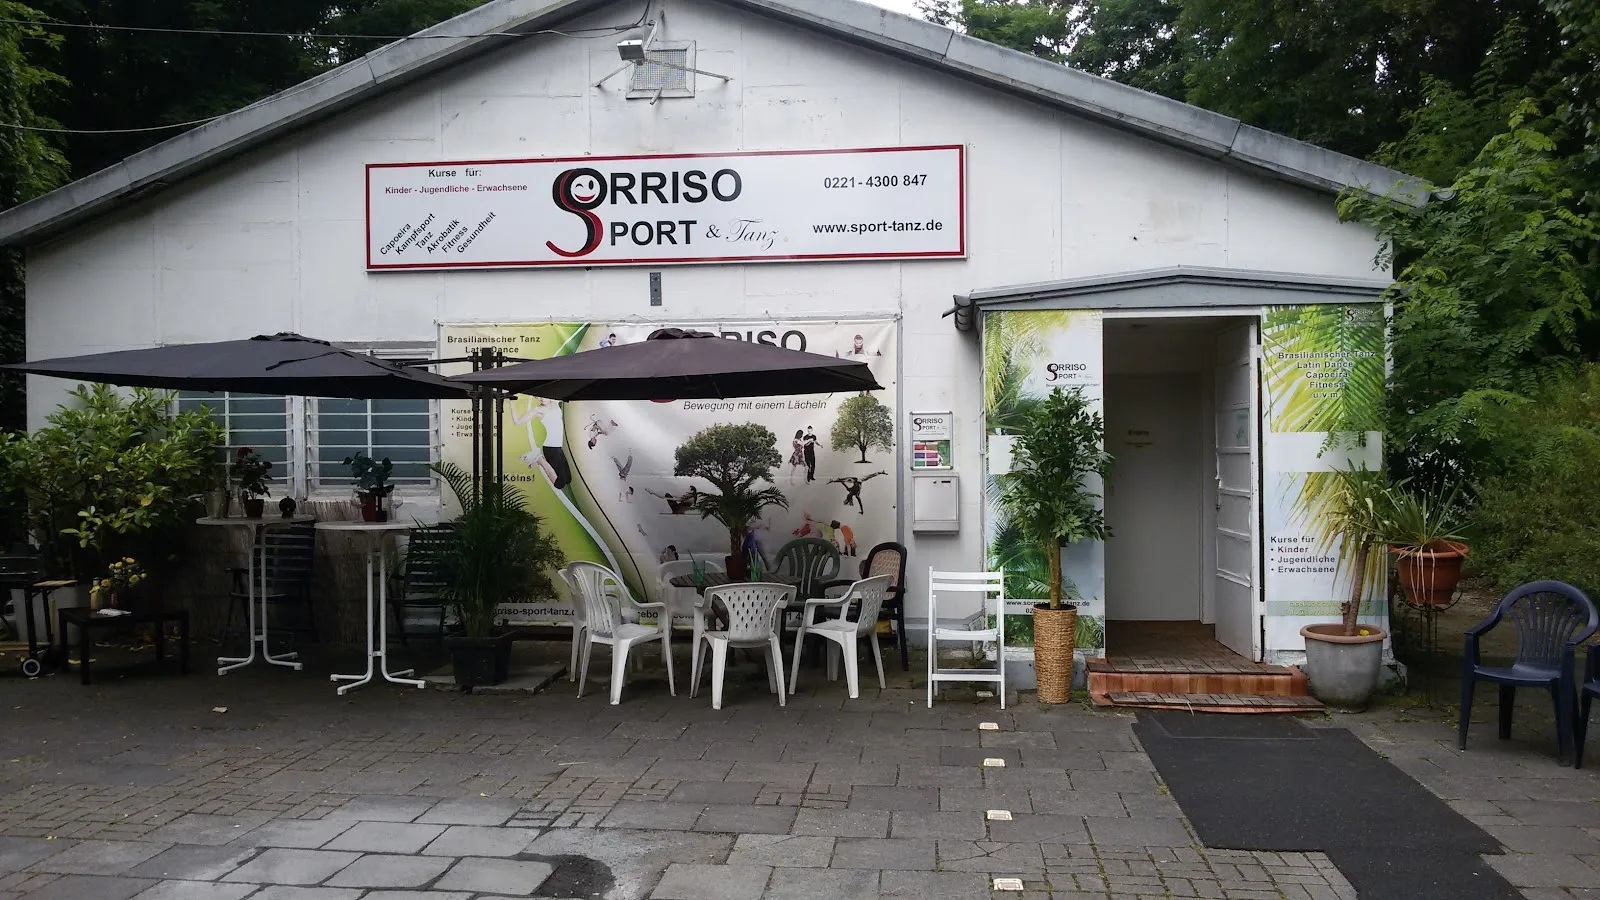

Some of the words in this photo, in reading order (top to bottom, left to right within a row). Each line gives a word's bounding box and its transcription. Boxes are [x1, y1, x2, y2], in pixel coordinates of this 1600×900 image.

[428, 169, 457, 178] Kurse
[465, 168, 482, 177] für:
[903, 174, 927, 186] 847
[385, 186, 412, 194] Kinder
[419, 185, 470, 195] Jugendliche
[476, 184, 528, 192] Erwachsene
[457, 211, 497, 254] Gesundheit
[813, 219, 943, 235] www.sport-tanz.de
[380, 223, 411, 255] Capoeira
[395, 213, 436, 255] Kampfsport
[427, 219, 460, 255] Akrobatik
[441, 226, 469, 254] Fitness
[706, 224, 721, 239] &
[726, 218, 779, 251] Tanz
[415, 231, 434, 250] Tanz
[519, 335, 541, 343] Tanz
[1278, 351, 1350, 359] Brasilianischer
[1354, 350, 1376, 358] Tanz
[1297, 361, 1321, 369] Latin
[1324, 361, 1353, 369] Dance
[1305, 371, 1348, 380] Capoeira
[1309, 381, 1345, 389] Fitness
[683, 400, 735, 412] Bewegung
[737, 400, 752, 410] mit
[754, 400, 785, 410] einem
[787, 400, 827, 410] Lächeln
[1301, 535, 1315, 543] für
[1277, 556, 1336, 564] Jugendliche
